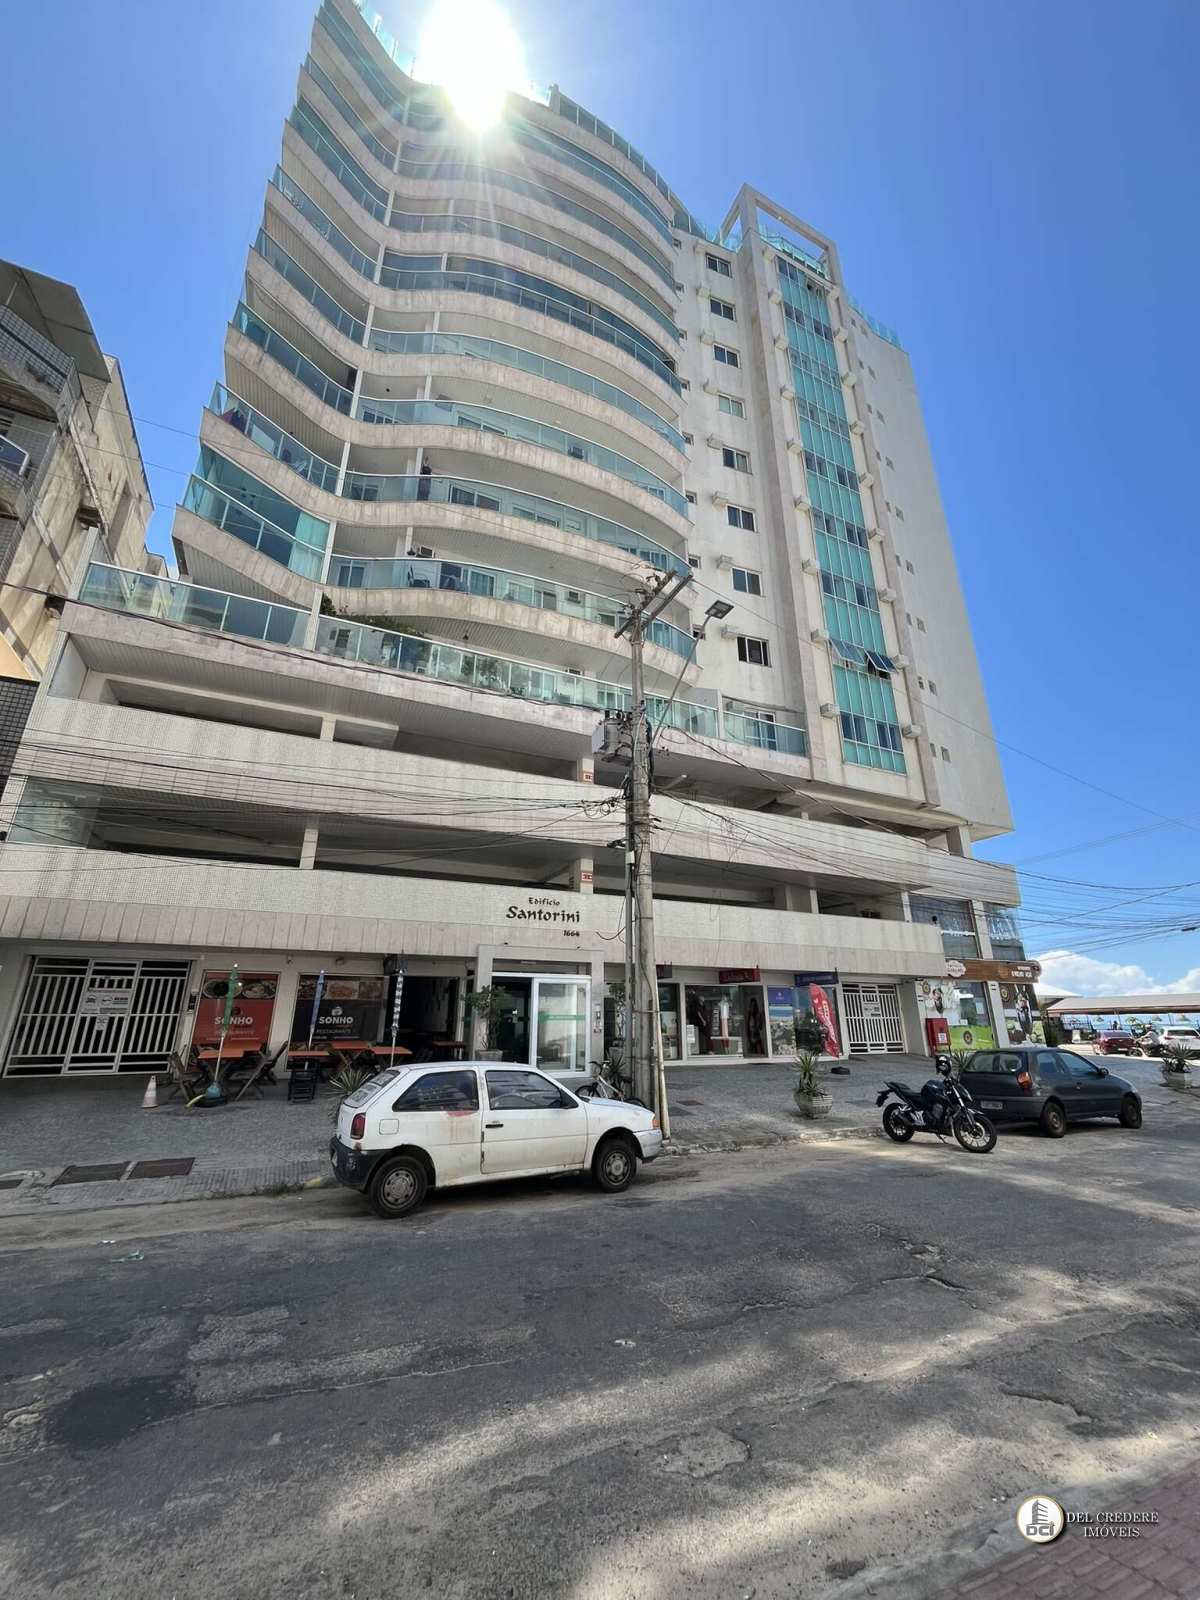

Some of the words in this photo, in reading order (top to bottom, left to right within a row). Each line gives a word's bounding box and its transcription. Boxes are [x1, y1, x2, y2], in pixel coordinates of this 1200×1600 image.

[528, 897, 560, 906] Edificio
[506, 905, 580, 923] Santorini
[214, 1016, 254, 1025] SNHO
[319, 1016, 354, 1025] SONHO
